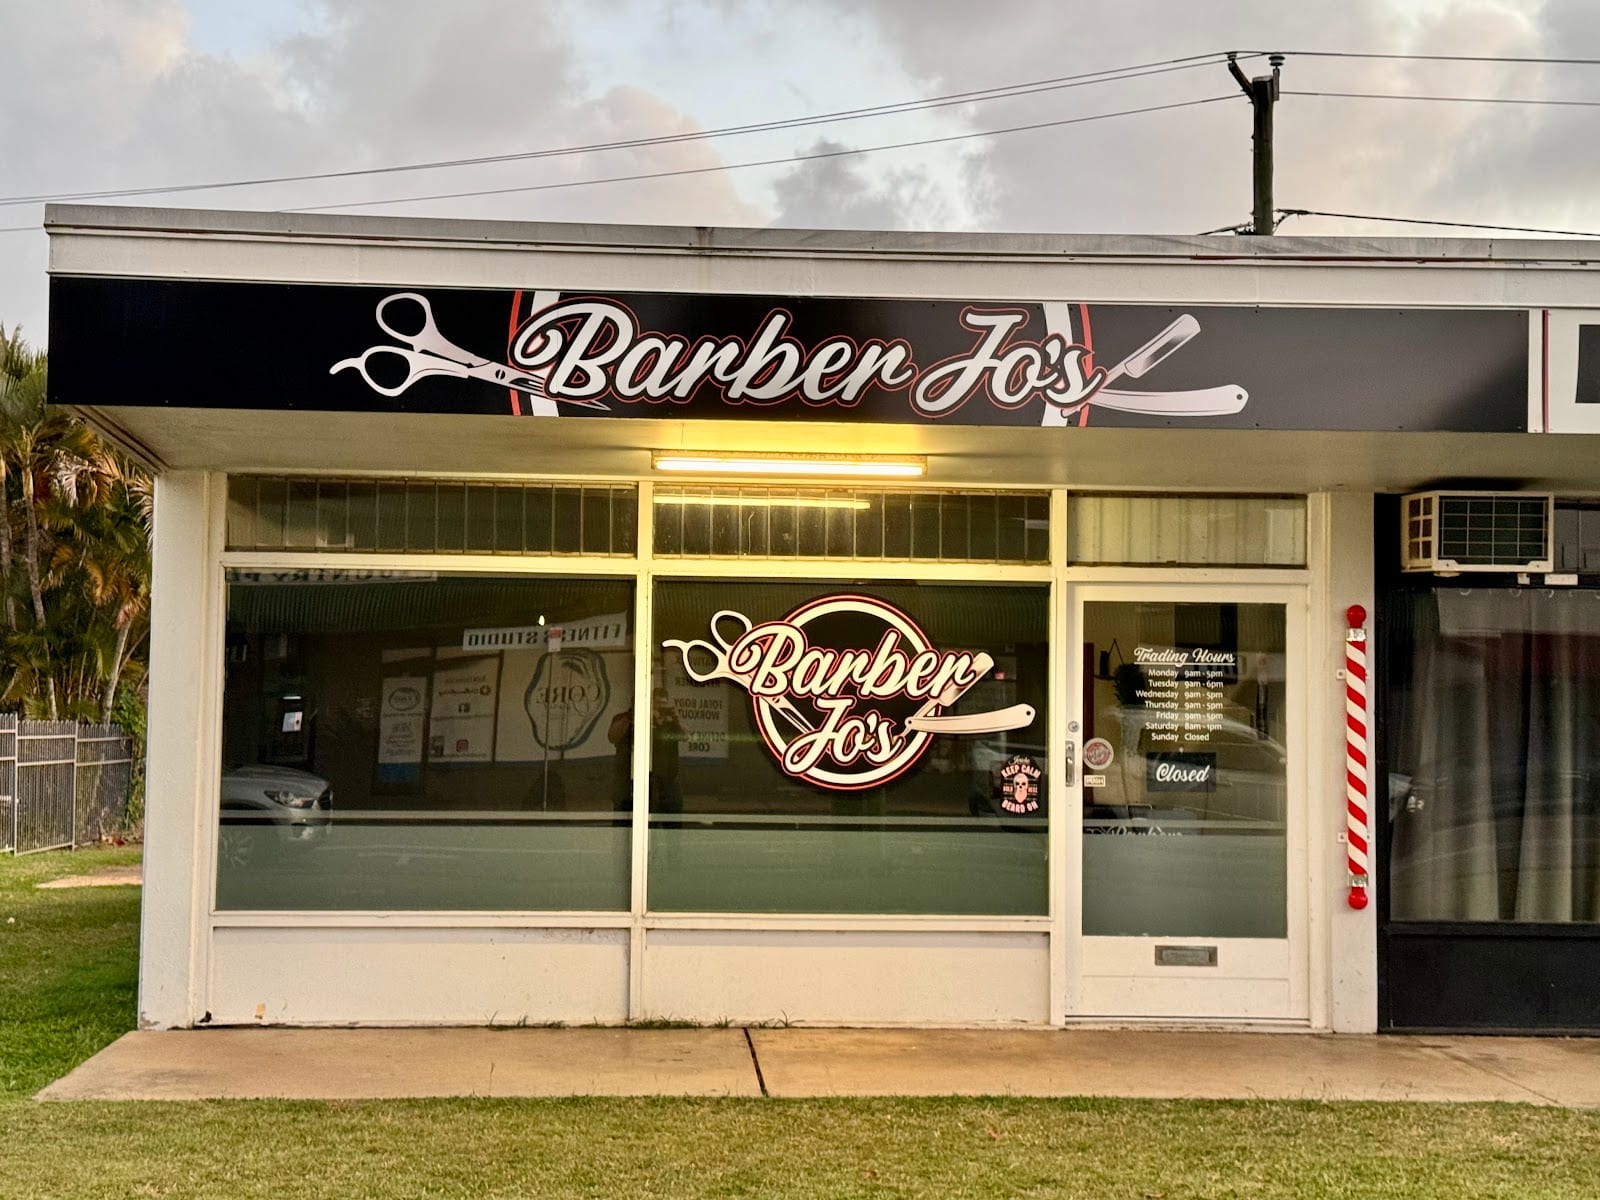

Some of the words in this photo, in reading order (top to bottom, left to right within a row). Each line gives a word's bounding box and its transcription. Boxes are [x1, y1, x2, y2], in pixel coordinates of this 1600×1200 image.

[512, 302, 914, 402] Barber
[914, 312, 1102, 412] Jo's
[730, 623, 975, 698] Barber
[1133, 647, 1189, 667] Trading
[1192, 648, 1235, 663] Hours
[1148, 669, 1179, 678] Monday
[1184, 670, 1201, 678] 9am
[1206, 670, 1223, 678] 5pm
[1148, 679, 1179, 689] Tuesday
[1184, 681, 1201, 689] 9am
[1206, 680, 1223, 689] 6pm
[1135, 690, 1179, 699] Wednesday
[1184, 691, 1201, 699] 9am
[1206, 691, 1223, 699] 5pm
[1144, 700, 1179, 710] Thursday
[1184, 702, 1201, 710] 9am
[1206, 702, 1223, 710] 5pm
[1156, 711, 1179, 721] Friday
[1184, 713, 1201, 721] 9am
[1206, 713, 1223, 721] 5pm
[1145, 721, 1179, 731] Saturday
[1184, 722, 1201, 730] 8am
[1206, 723, 1223, 731] 1pm
[784, 697, 903, 774] Jo's
[1151, 733, 1179, 742] Sunday
[1184, 733, 1210, 741] Closed
[1001, 765, 1020, 778] KEEP
[1021, 765, 1041, 778] CALM
[1155, 763, 1211, 782] Closed
[1002, 800, 1025, 813] BEARD
